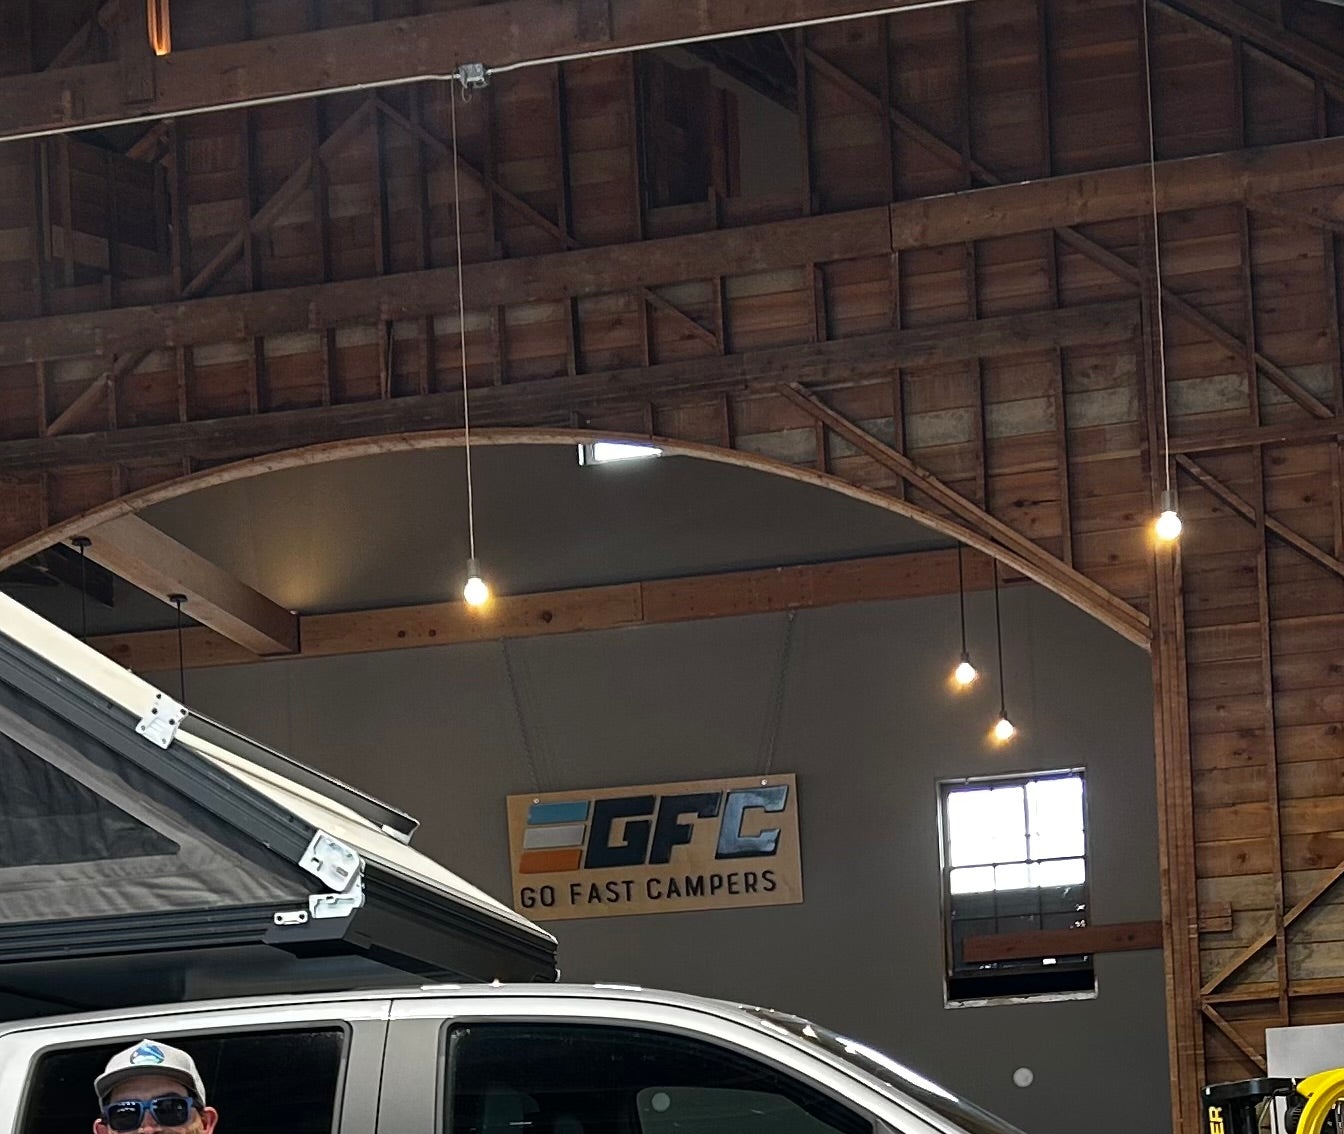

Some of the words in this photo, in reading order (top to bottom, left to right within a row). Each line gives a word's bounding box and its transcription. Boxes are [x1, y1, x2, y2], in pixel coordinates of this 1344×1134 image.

[584, 785, 789, 869] GFC
[520, 886, 555, 909] GO
[570, 880, 634, 905] FAST
[646, 869, 777, 899] CAMPERS
